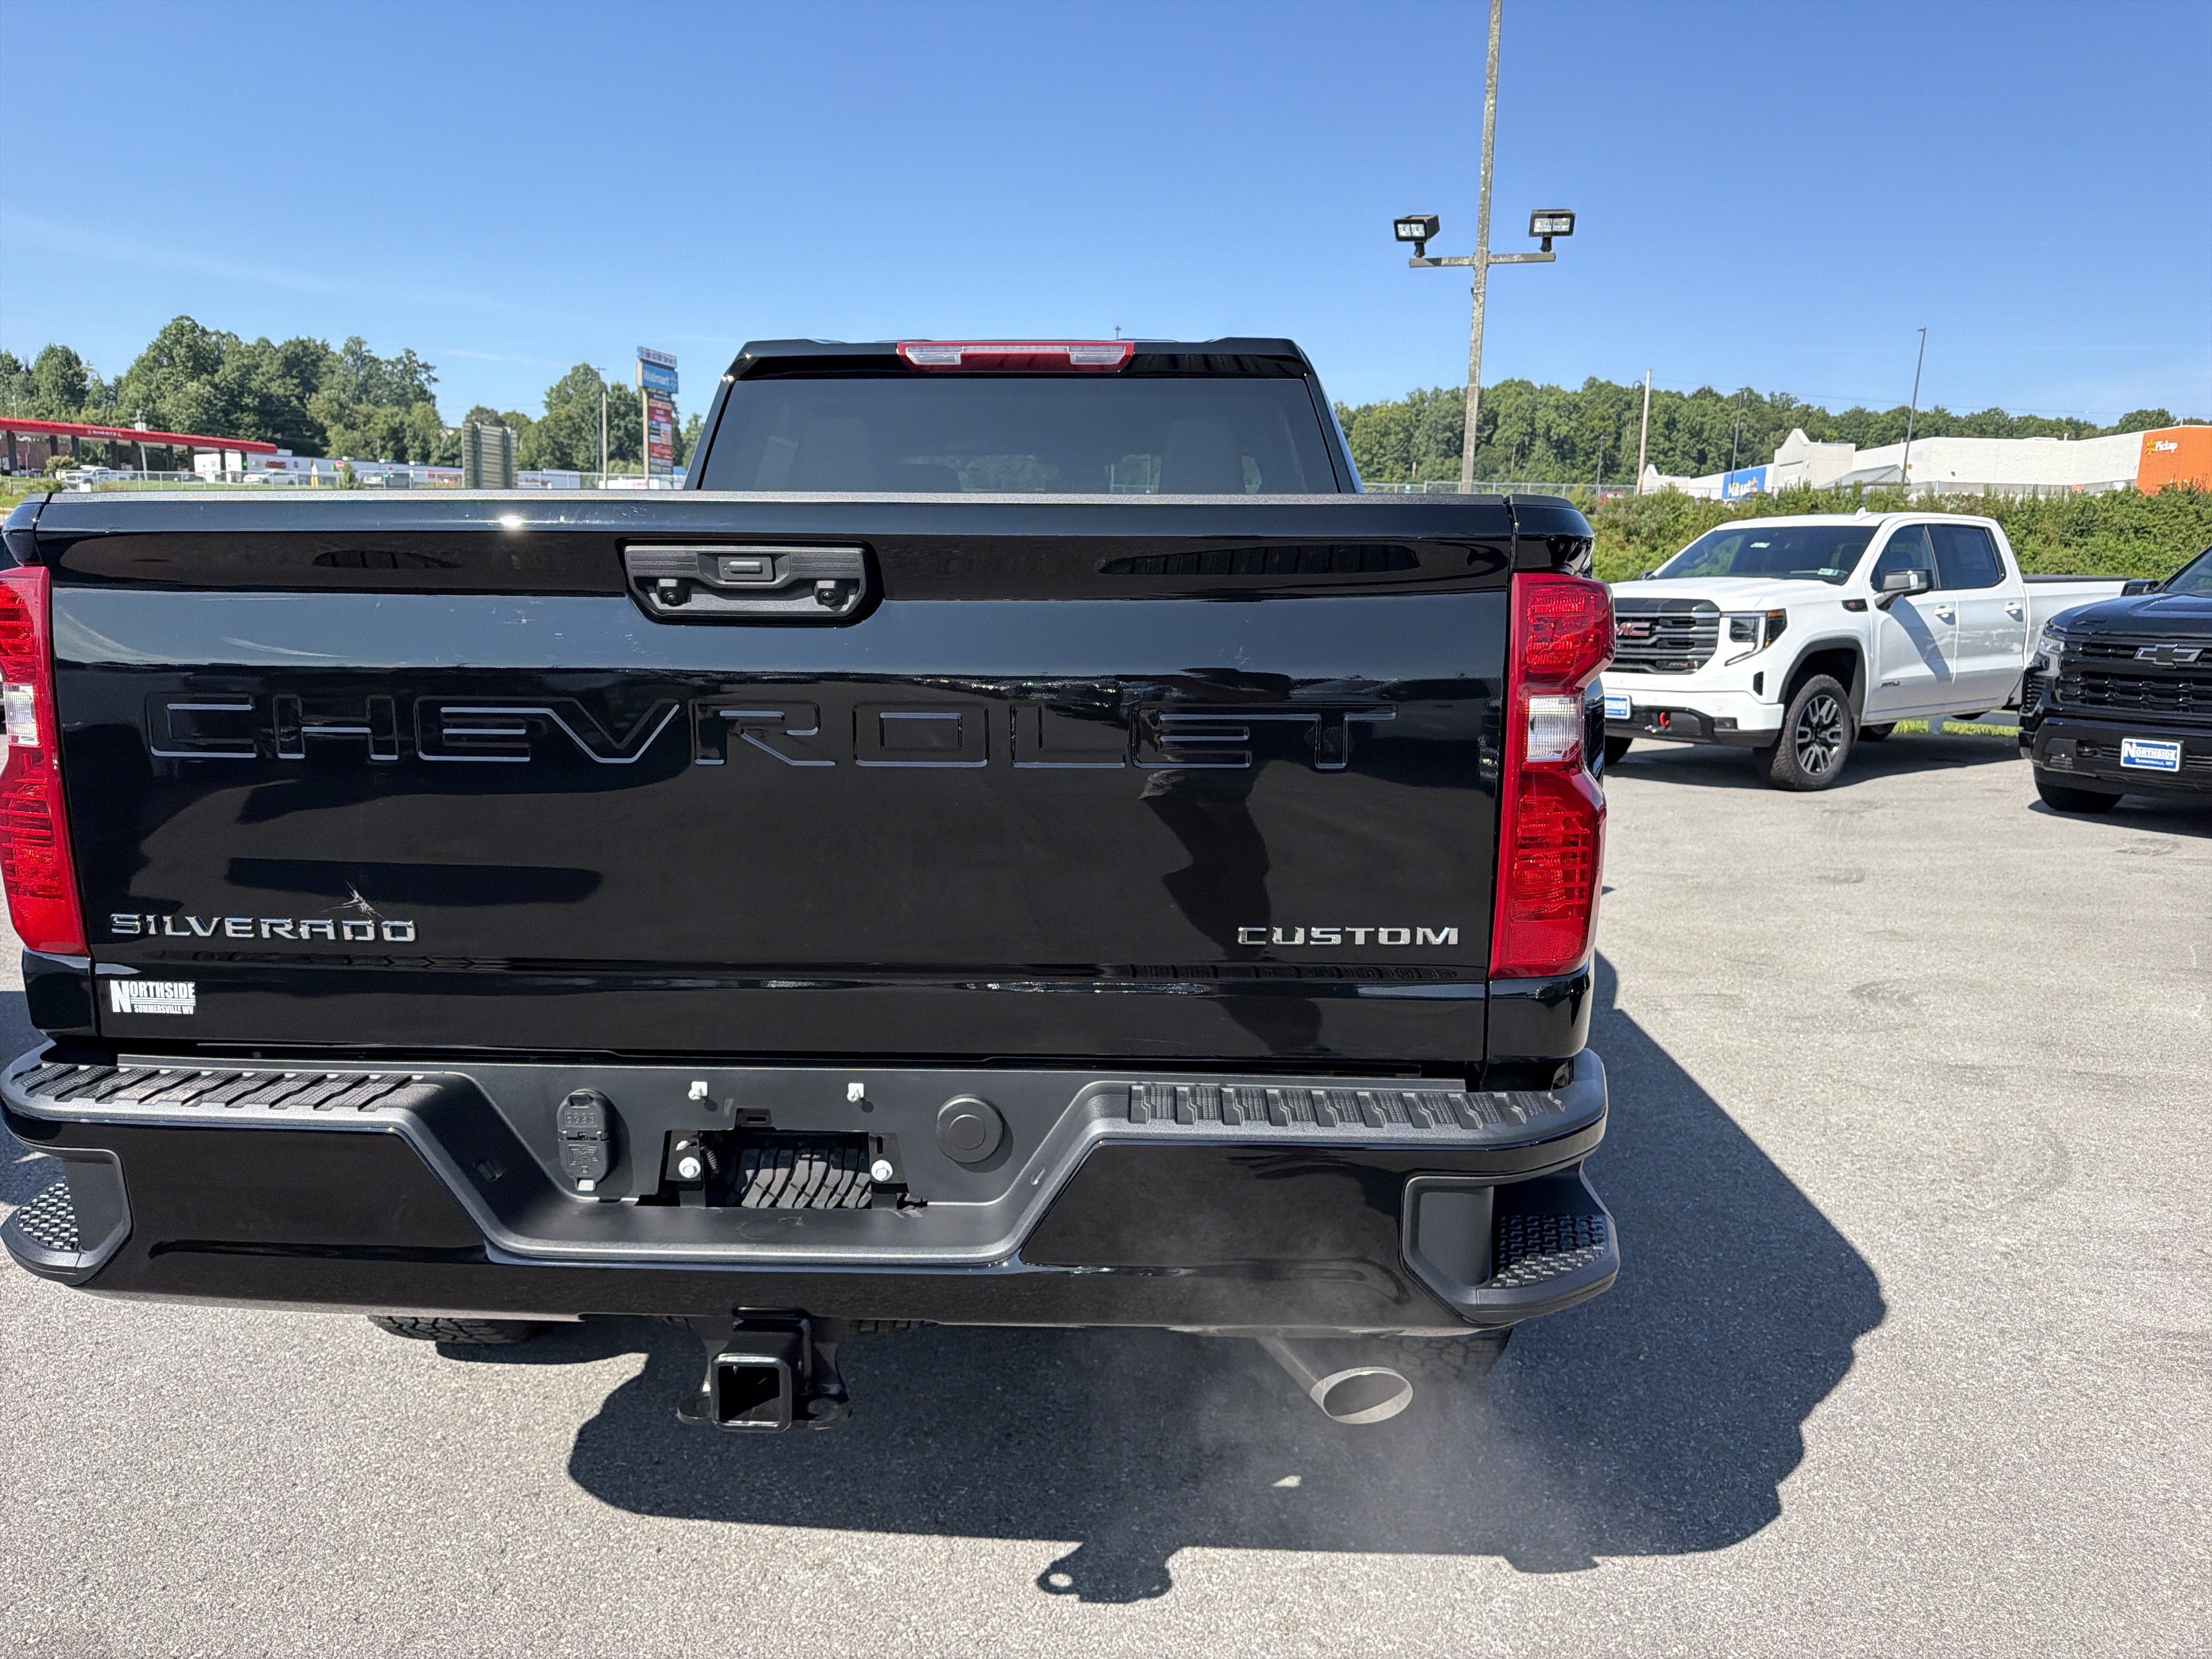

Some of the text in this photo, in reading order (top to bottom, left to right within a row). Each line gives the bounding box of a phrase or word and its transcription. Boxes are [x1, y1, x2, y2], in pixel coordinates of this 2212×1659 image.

[2155, 440, 2177, 454] Pickup
[1615, 622, 1650, 636] MC
[145, 693, 1397, 769] CHEVROLET
[2124, 743, 2176, 759] NORTHSIDE
[111, 913, 417, 942] SILVERADO
[1238, 927, 1458, 945] CUSTOM
[110, 980, 196, 1013] NORTHSIDE
[134, 1004, 194, 1014] SUMMERSVILLE WV
